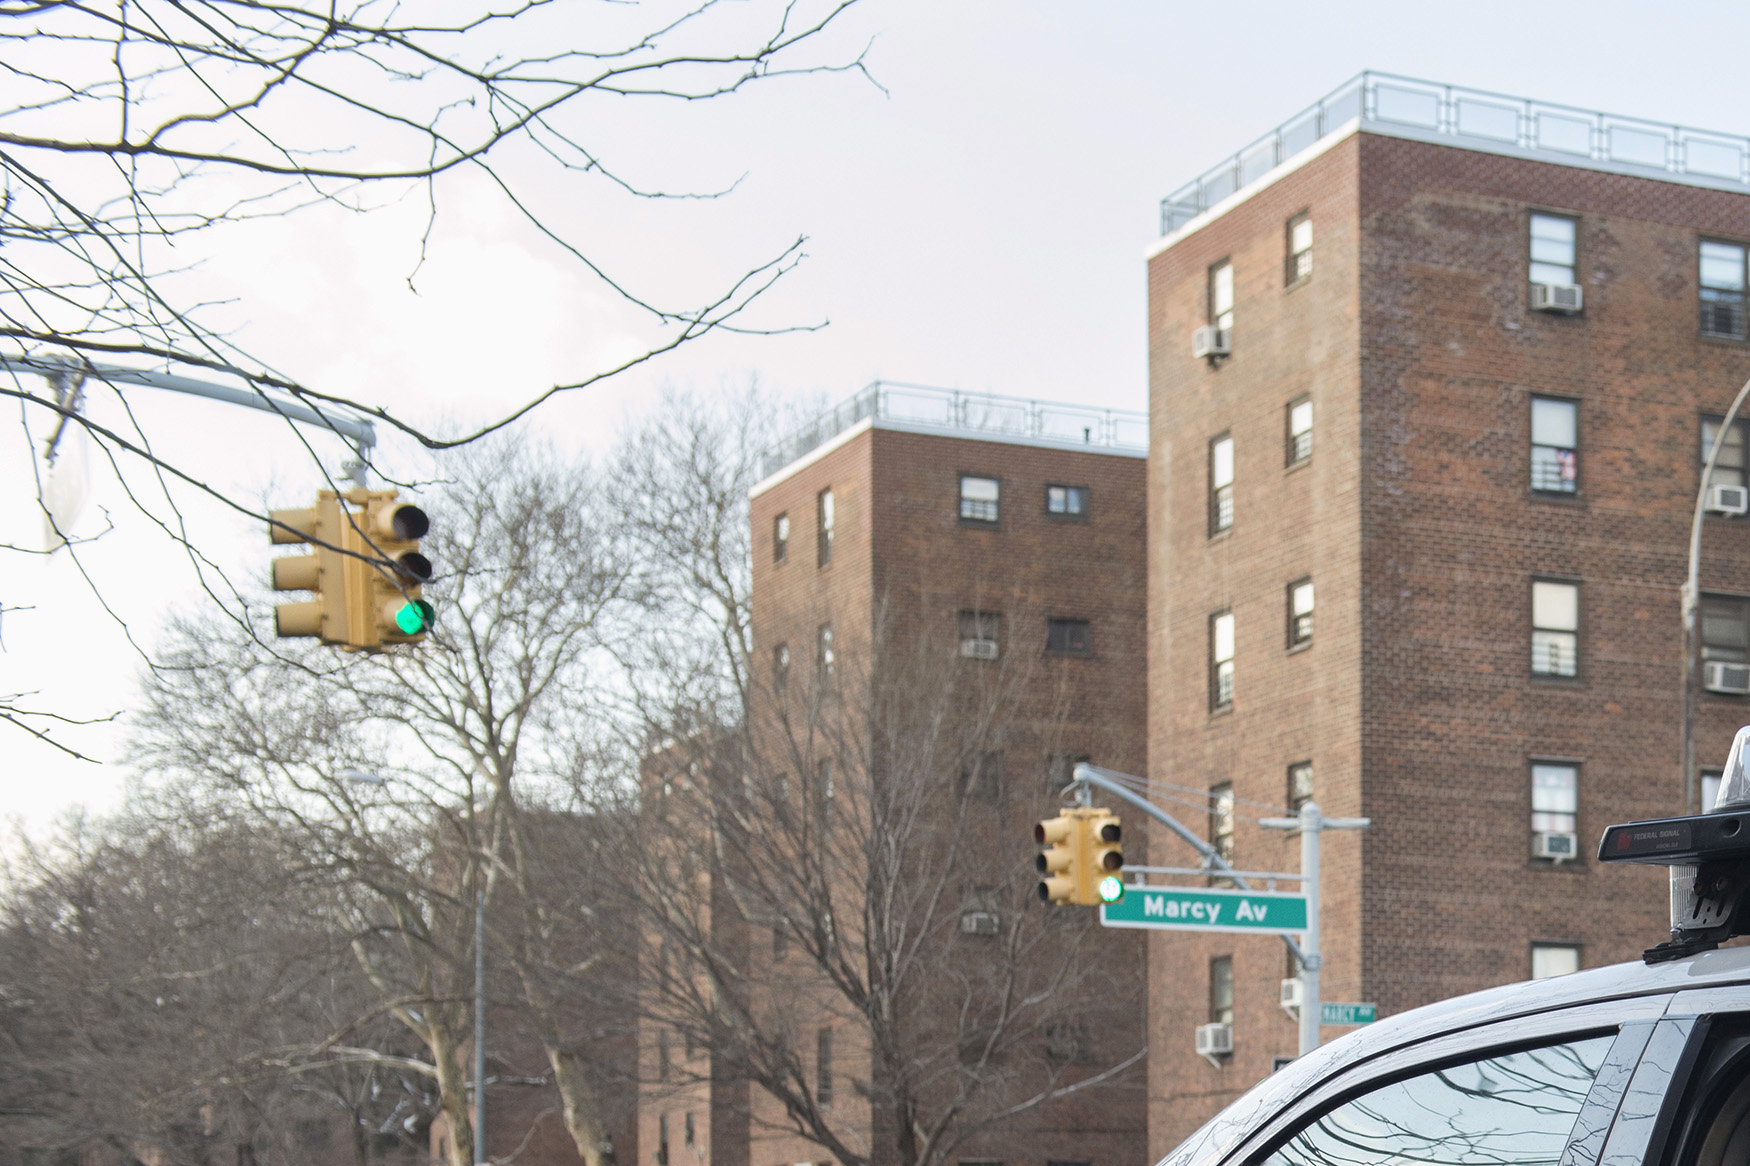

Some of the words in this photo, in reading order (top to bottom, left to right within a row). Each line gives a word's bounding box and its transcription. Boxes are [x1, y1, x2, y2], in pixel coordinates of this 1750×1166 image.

[1633, 831, 1658, 840] FEDERAL
[1659, 829, 1680, 838] SIGNAL
[1144, 895, 1221, 924] Marcy
[1235, 899, 1268, 921] Av
